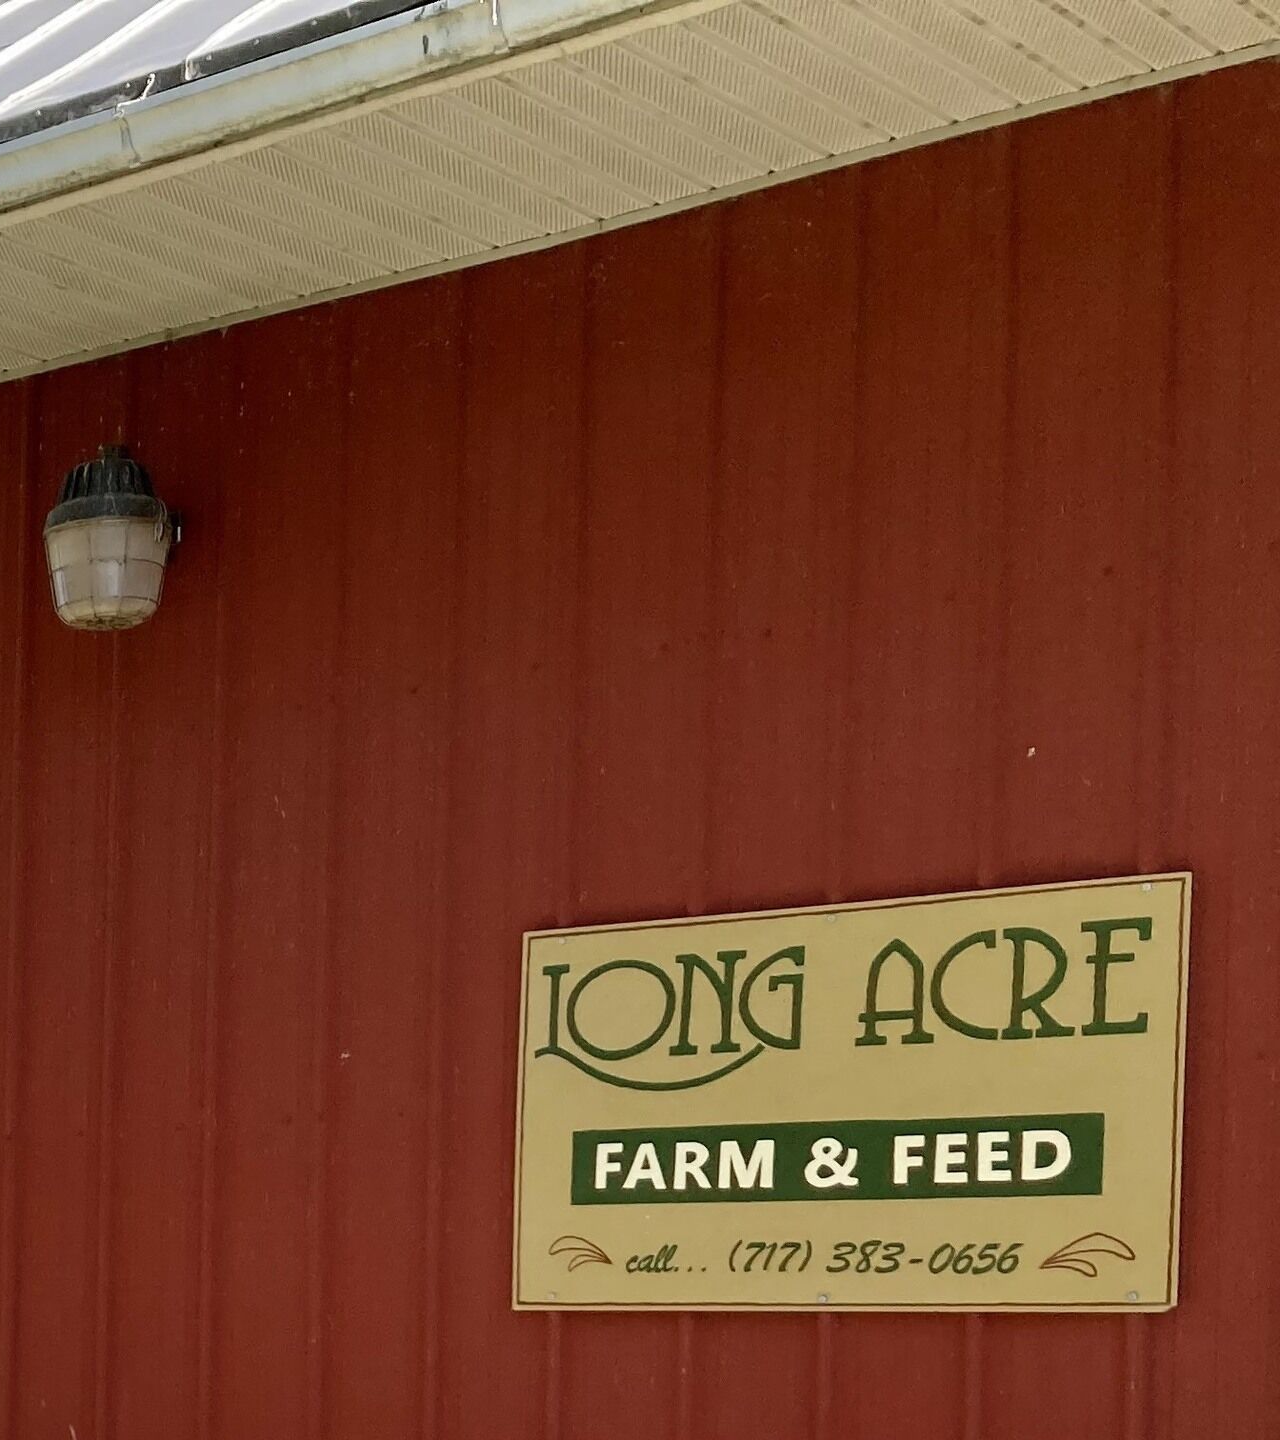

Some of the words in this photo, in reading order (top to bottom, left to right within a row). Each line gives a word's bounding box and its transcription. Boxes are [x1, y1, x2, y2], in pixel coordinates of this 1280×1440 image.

[535, 945, 806, 1092] LONG
[855, 917, 1153, 1047] ACRE
[594, 1139, 776, 1190] FARM
[804, 1136, 860, 1188] &
[892, 1129, 1073, 1186] FEED
[625, 1241, 707, 1275] call...
[728, 1239, 814, 1276] (717)
[826, 1241, 1025, 1276] 383-0656
